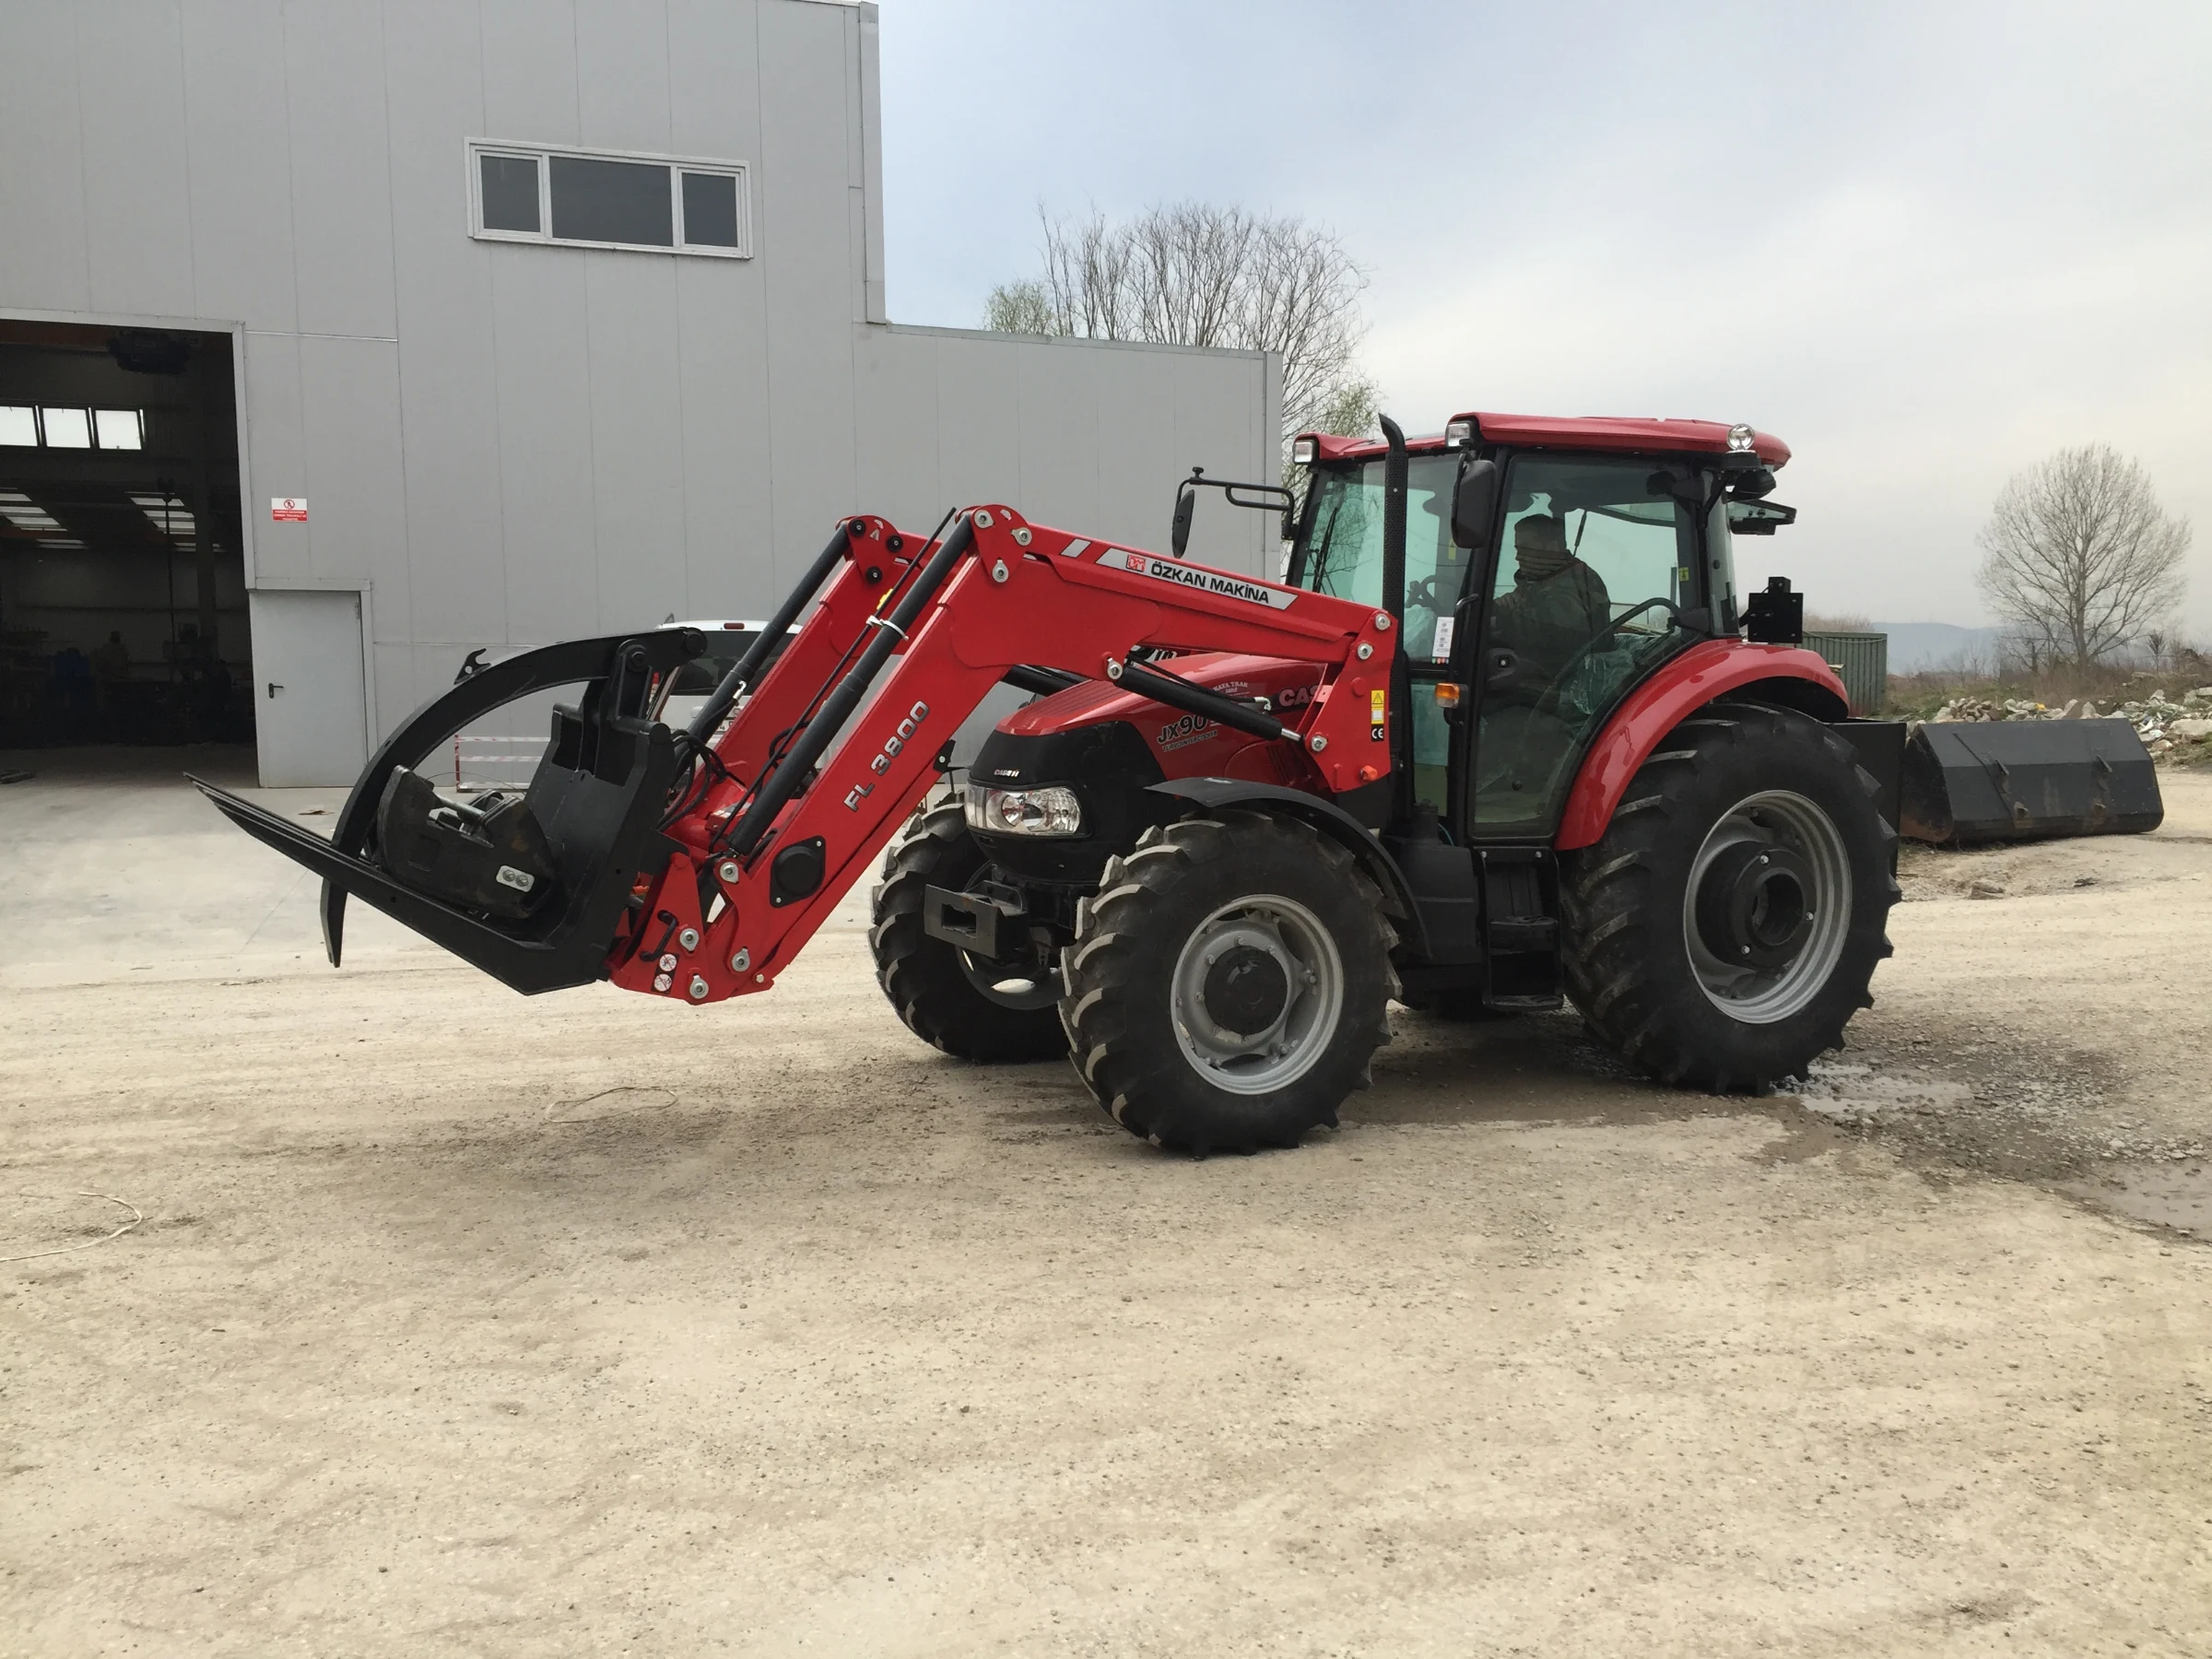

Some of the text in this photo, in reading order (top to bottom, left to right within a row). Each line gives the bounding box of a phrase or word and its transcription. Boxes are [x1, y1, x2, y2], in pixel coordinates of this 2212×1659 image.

[1150, 560, 1206, 588] ÖZKAN
[1209, 577, 1269, 604] MAKİNA
[1213, 682, 1230, 692] KAYA
[1278, 685, 1319, 707] CAS
[1371, 727, 1383, 739] CE
[843, 700, 930, 812] FL 3800
